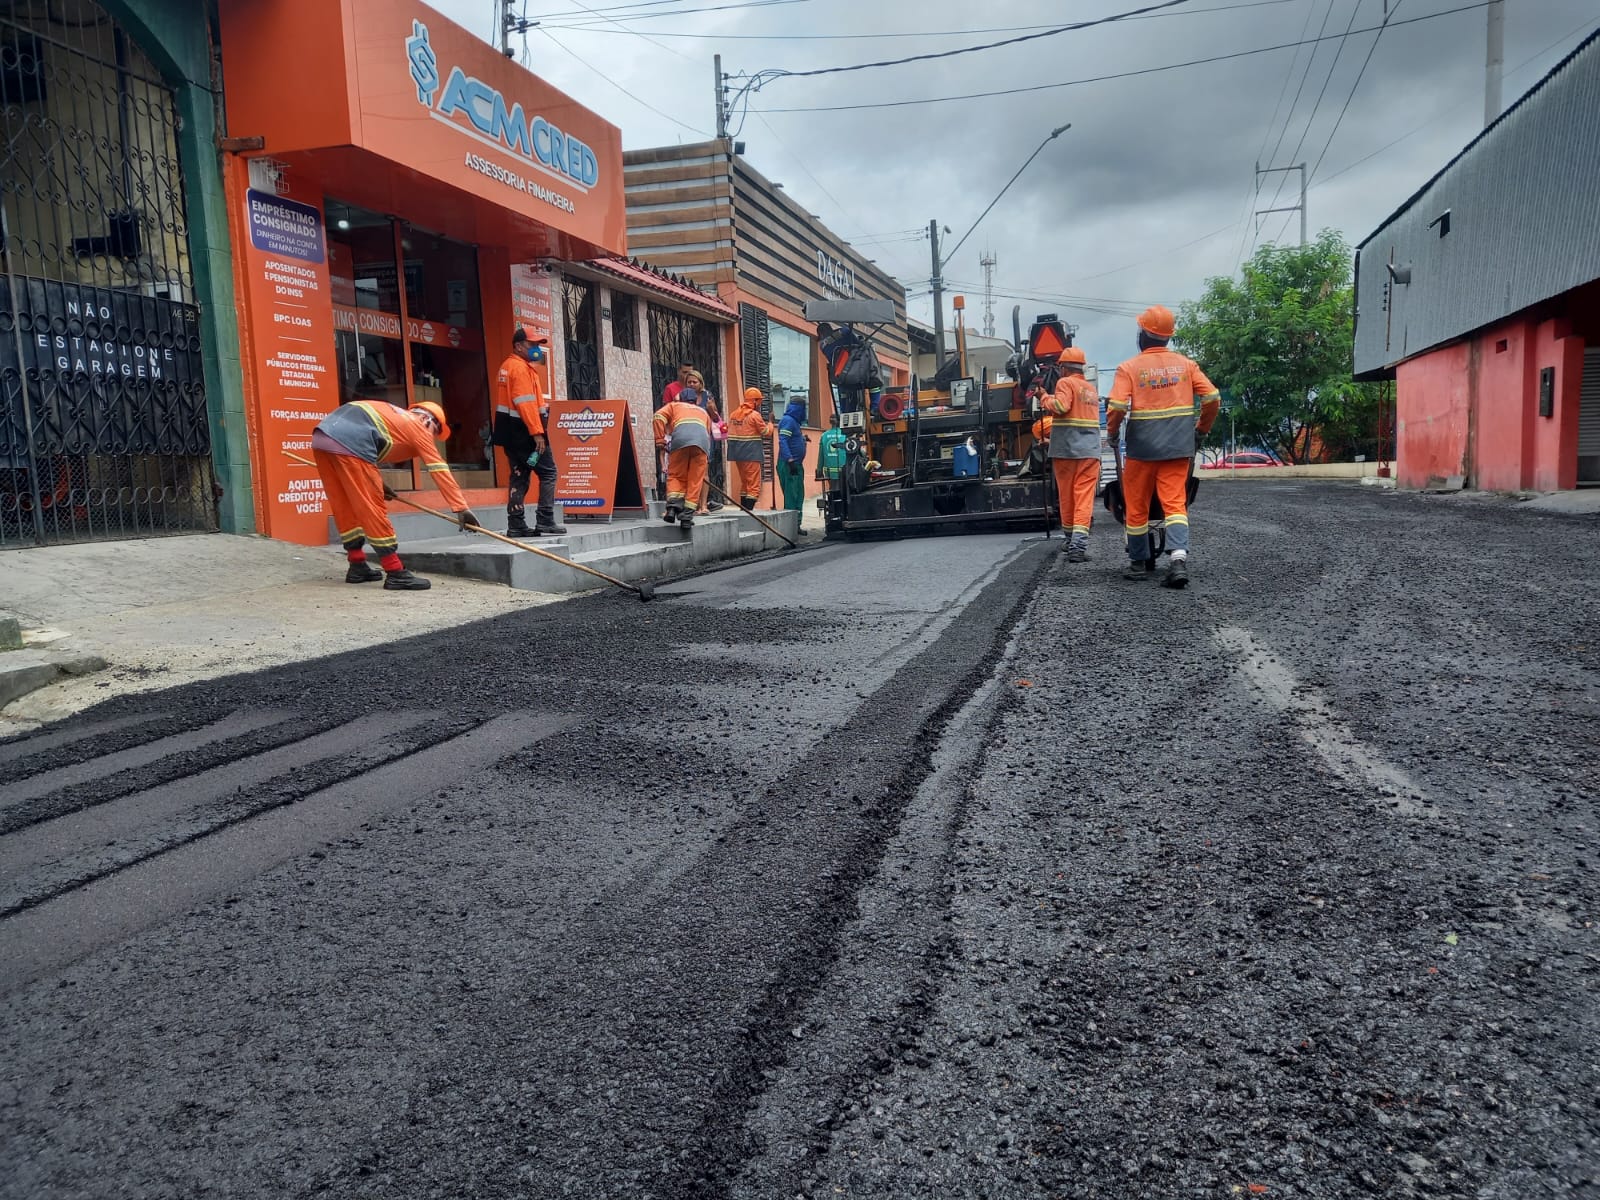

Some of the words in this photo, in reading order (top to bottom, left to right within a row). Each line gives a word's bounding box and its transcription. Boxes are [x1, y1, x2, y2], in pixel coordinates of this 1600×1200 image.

[437, 66, 532, 158] ACM
[530, 115, 598, 188] CRED
[465, 152, 526, 192] ASSESSORIA
[527, 180, 576, 214] FINANCEIRA
[252, 200, 315, 226] EMPRÉSTIMO
[253, 213, 316, 238] CONSIGNADO
[256, 229, 286, 243] DINHEIRO
[287, 237, 296, 246] NA
[296, 239, 318, 250] CONTA
[269, 241, 278, 249] EM
[279, 242, 308, 257] MINUTOS!
[265, 260, 316, 279] APOSENTADOS
[264, 271, 270, 280] E
[270, 272, 318, 290] PENSIONISTAS
[275, 285, 287, 294] DO
[287, 286, 303, 298] INSS
[68, 302, 110, 319] NÃO
[273, 313, 291, 324] BPC
[291, 316, 312, 327] LOAS
[332, 309, 355, 329] TIMO
[359, 313, 419, 339] CONSIGNDO
[37, 334, 173, 361] ESTACIONE
[277, 351, 317, 362] SERVIDORES
[58, 356, 161, 378] GARAGEM
[266, 358, 299, 370] PÚBLICOS
[299, 363, 327, 373] FEDERAL
[281, 370, 315, 380] ESTADUAL
[279, 378, 284, 386] E
[284, 379, 320, 389] MUNICIPAL
[270, 409, 300, 422] FORÇAS
[300, 411, 330, 421] ARMADA
[557, 420, 615, 429] CONSIGNADO
[282, 441, 306, 450] SAQUE
[288, 479, 309, 491] AQUI
[278, 489, 315, 503] CRÉDITO
[315, 491, 328, 501] PA
[296, 501, 323, 514] VOCÊ!
